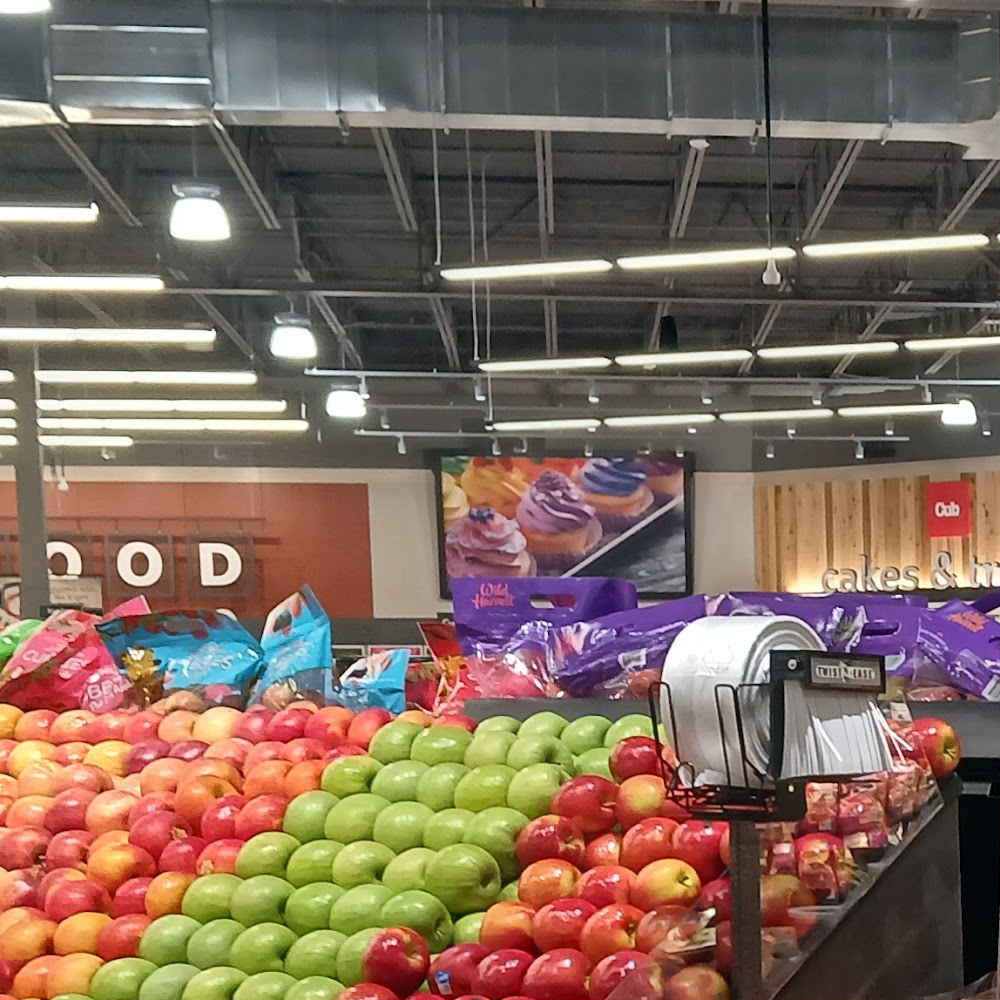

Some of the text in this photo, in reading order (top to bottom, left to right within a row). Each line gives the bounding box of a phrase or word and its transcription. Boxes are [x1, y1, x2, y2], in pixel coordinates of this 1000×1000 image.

[934, 501, 961, 518] Cub
[821, 553, 920, 594] cakes
[930, 550, 958, 590] &
